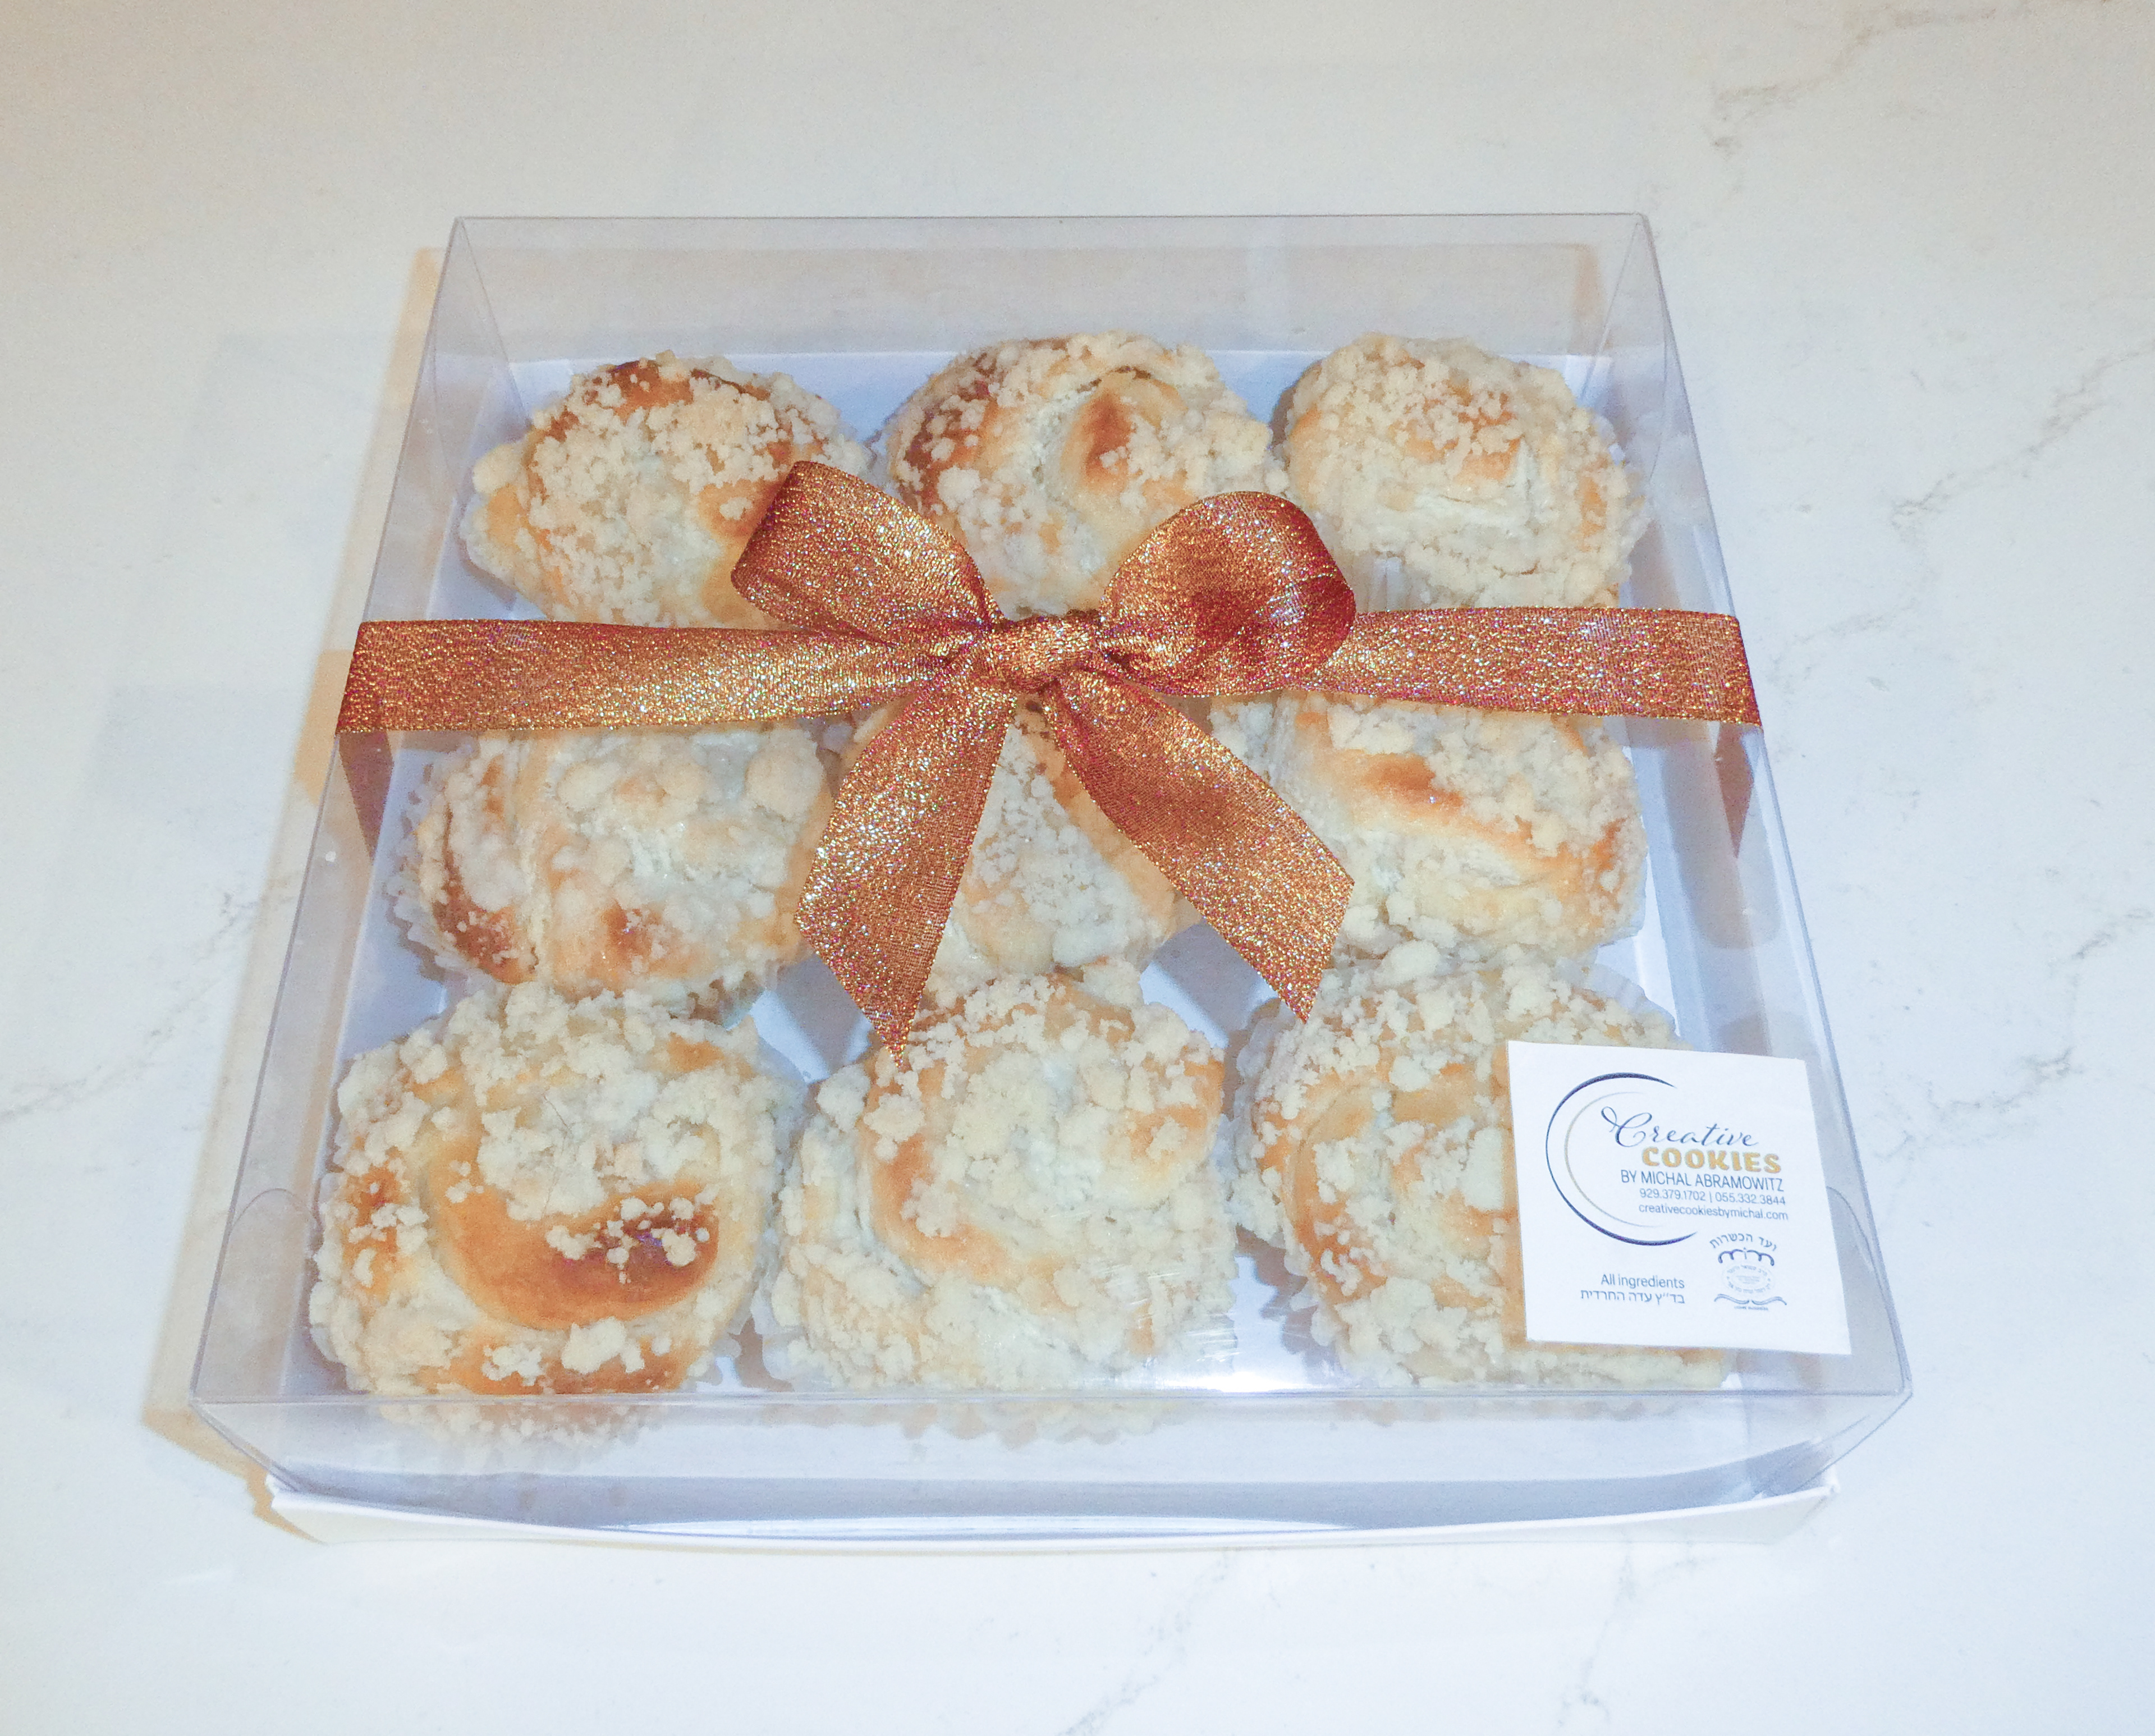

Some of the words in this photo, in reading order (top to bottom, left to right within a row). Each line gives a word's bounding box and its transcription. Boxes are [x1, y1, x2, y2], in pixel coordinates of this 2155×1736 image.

[1601, 1106, 1759, 1147] Creative
[1642, 1147, 1781, 1174] COOKIES
[1621, 1169, 1636, 1183] BY
[1641, 1171, 1692, 1186] MICHAL
[1695, 1174, 1784, 1192] ABRAMOWITZ
[1639, 1188, 1705, 1201] 929.379.1702
[1716, 1192, 1785, 1205] 055.332.3844
[1639, 1203, 1788, 1220] creativecookiesbymichal.com
[1709, 1233, 1753, 1248] הכשרות
[1601, 1274, 1615, 1285] All
[1618, 1274, 1685, 1289] ingredients
[1581, 1290, 1625, 1300] החרדית
[1629, 1292, 1652, 1302] עדה
